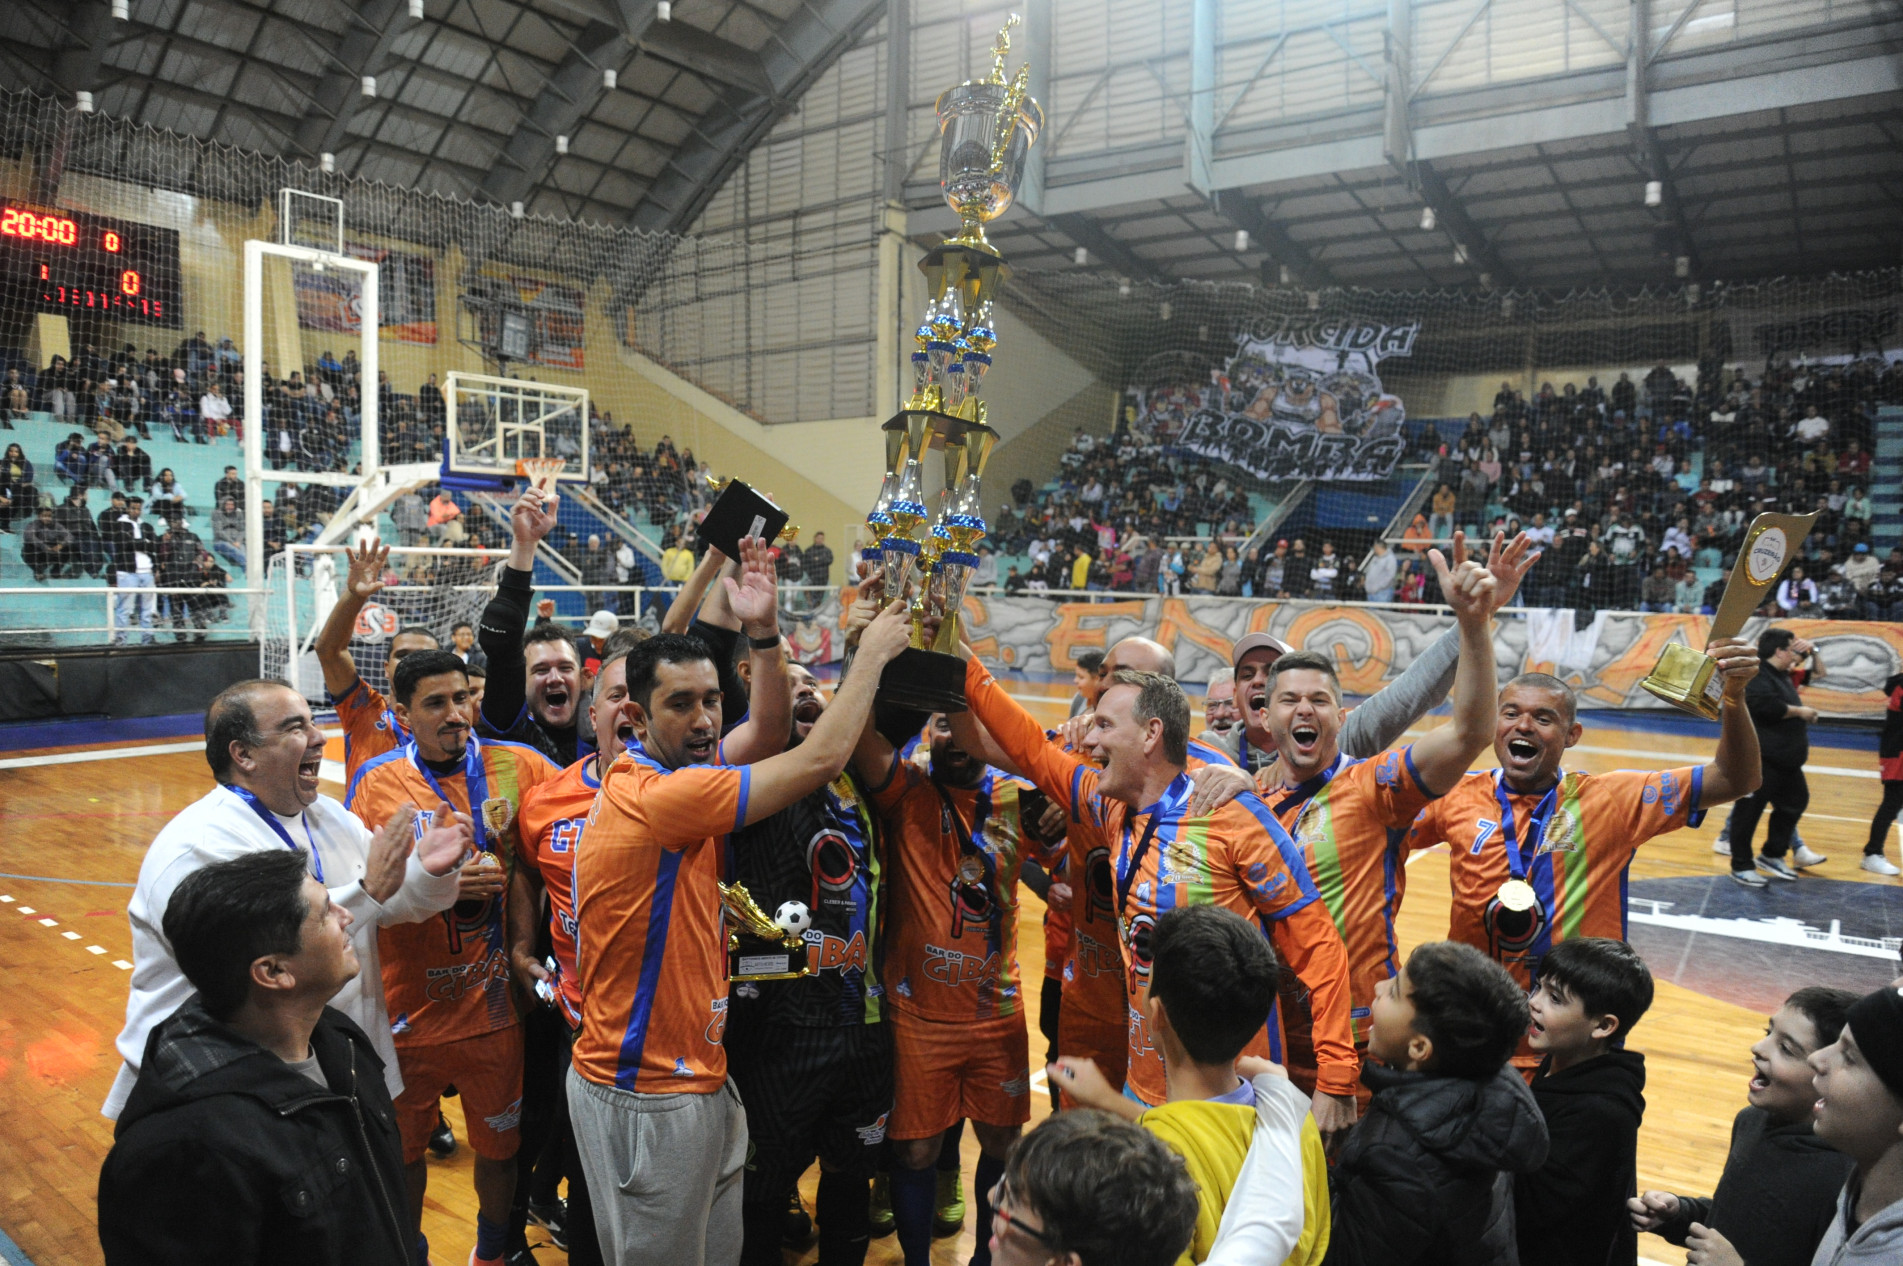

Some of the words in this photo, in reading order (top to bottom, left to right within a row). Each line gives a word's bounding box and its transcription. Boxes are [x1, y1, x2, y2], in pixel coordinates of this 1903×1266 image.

[1, 208, 77, 245] 20:00
[105, 232, 120, 252] 0
[122, 270, 140, 296] 0
[1175, 409, 1405, 480] BOMBA
[1471, 818, 1498, 855] 7
[806, 930, 822, 941] DO
[806, 929, 867, 977] IBA
[926, 945, 945, 957] BAR
[947, 951, 962, 960] DO
[426, 947, 511, 1002] GIBA
[427, 969, 449, 978] BAR
[452, 965, 467, 974] DO
[922, 951, 1002, 987] GIBA
